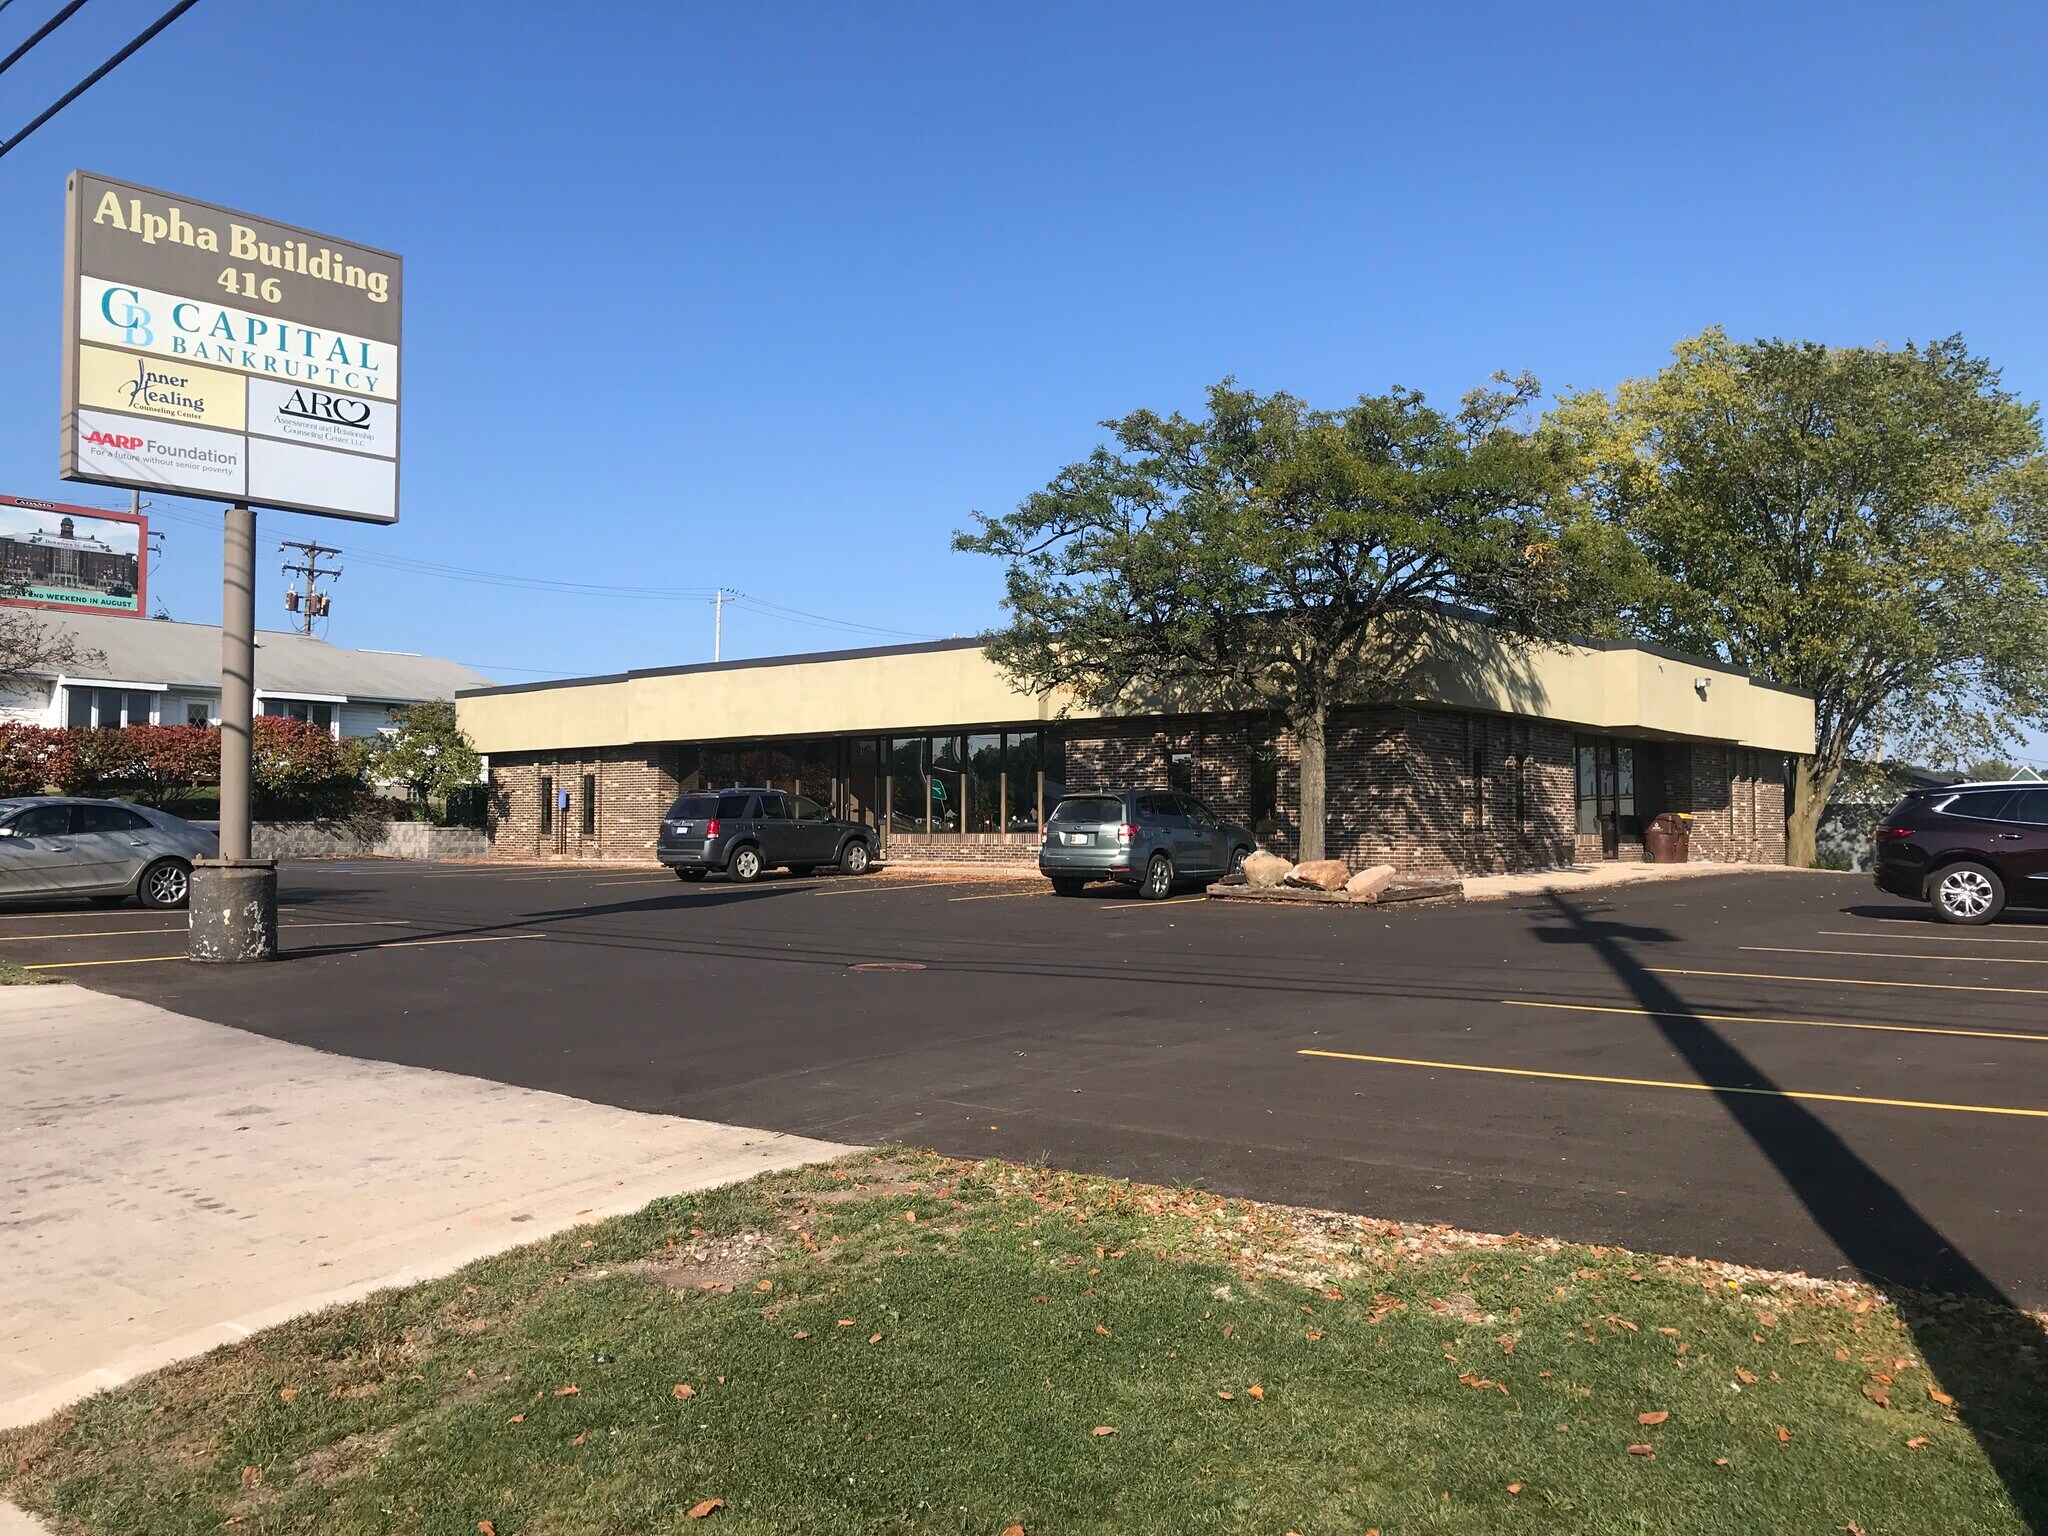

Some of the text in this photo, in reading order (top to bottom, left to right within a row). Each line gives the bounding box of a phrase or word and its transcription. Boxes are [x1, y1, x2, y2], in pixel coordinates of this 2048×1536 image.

[93, 190, 389, 303] Alpha Building
[217, 267, 282, 304] 416
[172, 303, 379, 371] CAPITAL
[138, 358, 189, 388] Inner
[172, 336, 379, 392] BANKRUPTCY
[118, 380, 205, 412] Healing
[133, 403, 202, 420] Counseling Center
[274, 415, 375, 441] Assessment and Relationship
[283, 425, 324, 441] Counseling
[81, 430, 238, 466] AARP Foundation
[90, 447, 105, 456] For
[115, 451, 140, 462] future
[142, 455, 174, 467] without
[176, 461, 200, 470] senior
[202, 465, 235, 477] poverty.
[46, 593, 87, 604] WEEKEND
[100, 600, 132, 608] AUGUST
